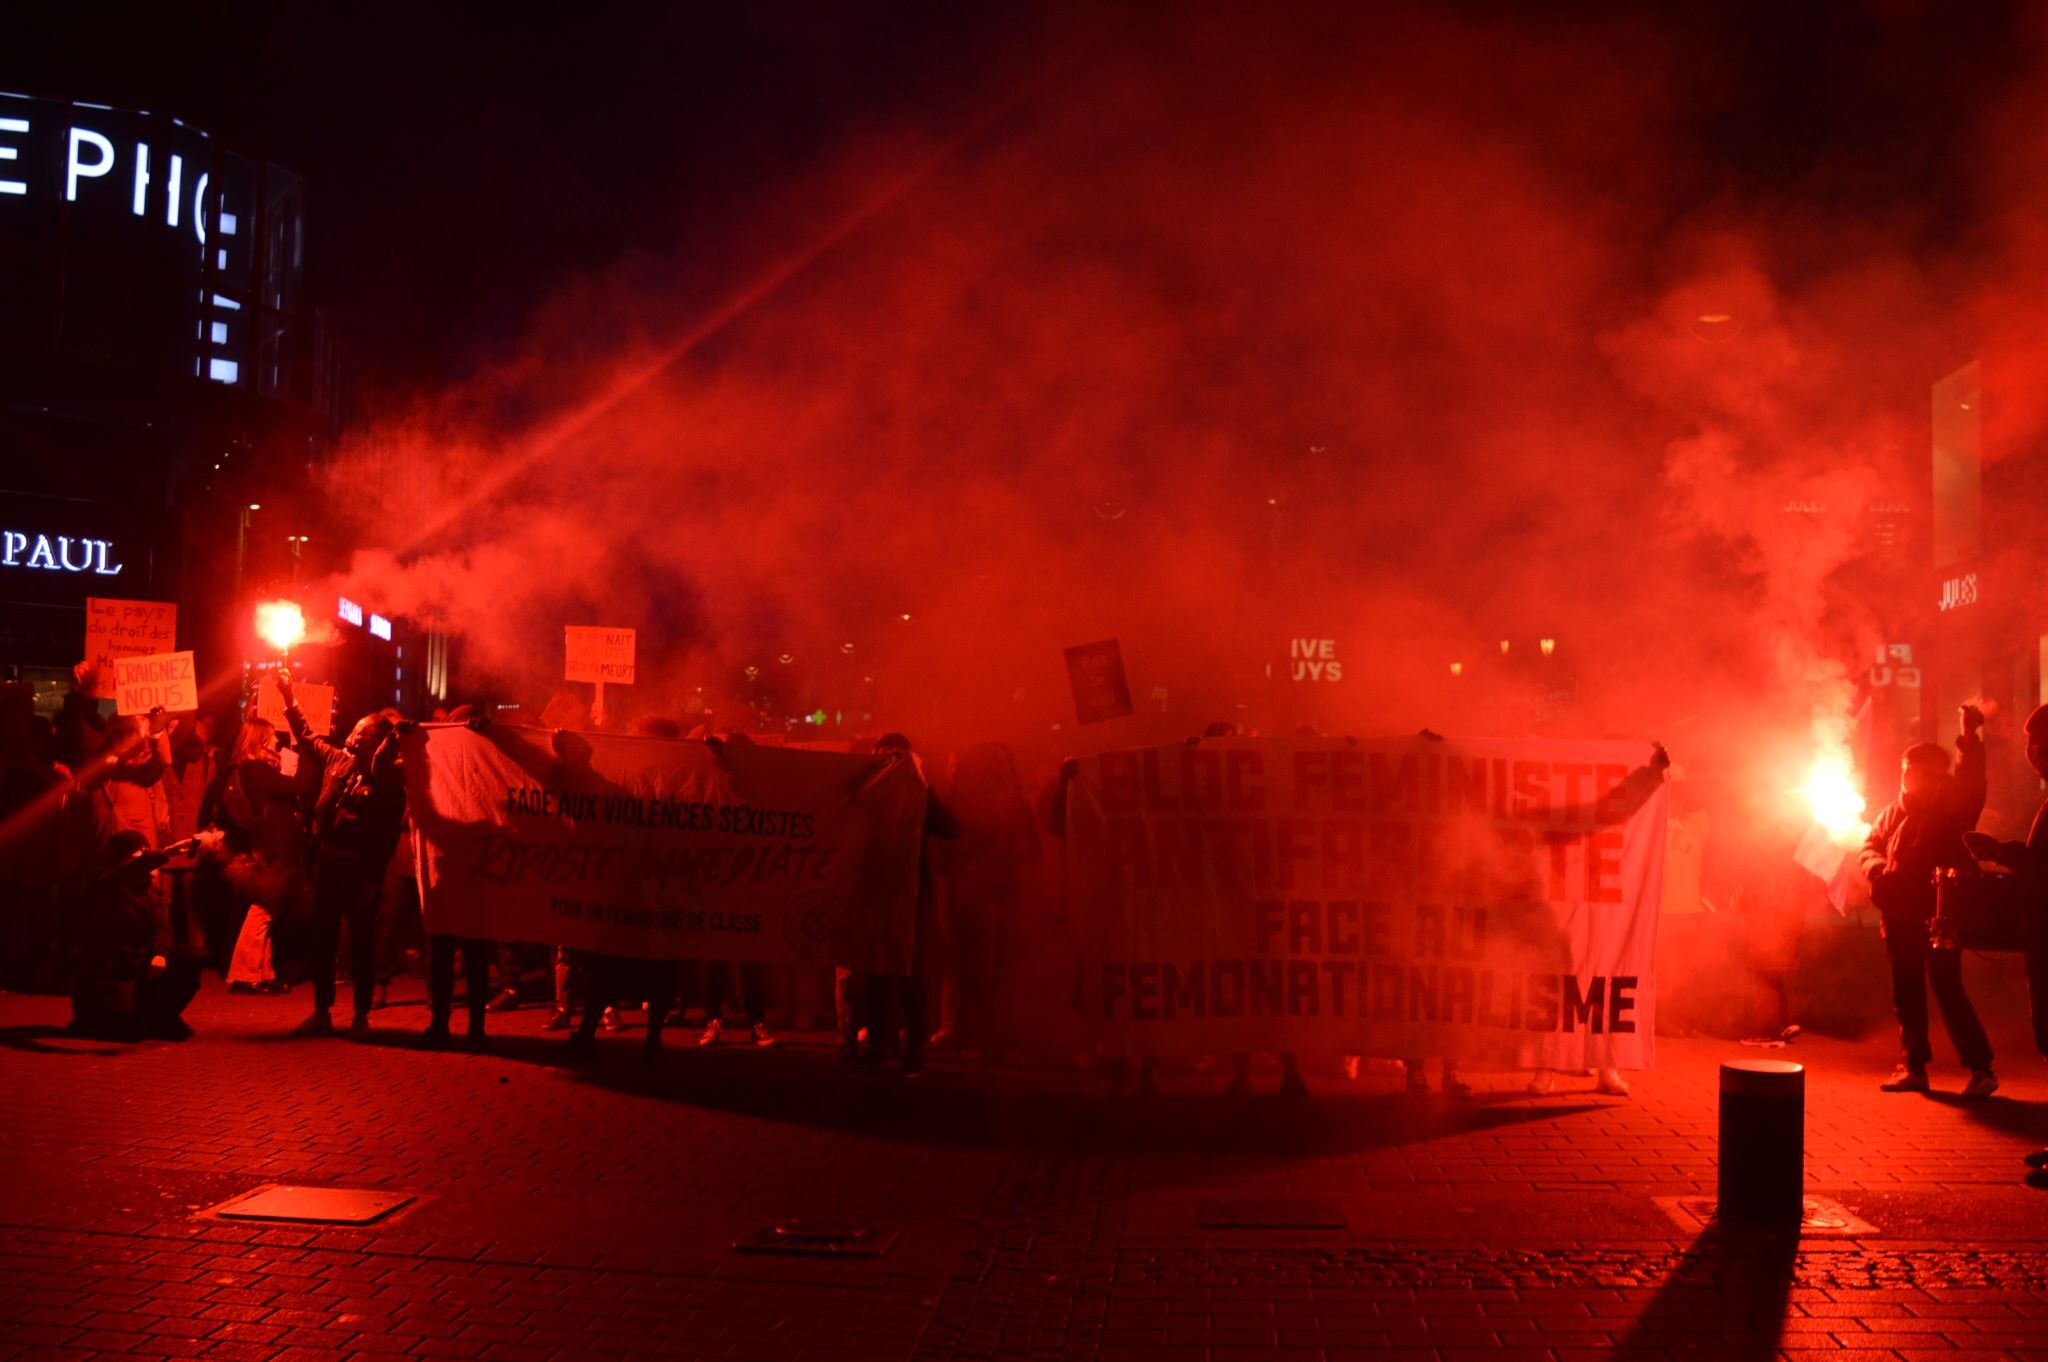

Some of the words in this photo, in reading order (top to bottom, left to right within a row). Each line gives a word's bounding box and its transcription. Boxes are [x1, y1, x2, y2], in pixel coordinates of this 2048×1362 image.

[2, 530, 122, 575] PAUL
[1937, 573, 1977, 612] JULES
[89, 618, 106, 635] du
[91, 600, 115, 617] Le
[123, 606, 165, 626] pays
[606, 633, 633, 646] NAIT
[1290, 637, 1337, 659] IVE
[116, 658, 192, 686] CRAIGNEZ
[600, 663, 634, 679] MEURT
[1266, 660, 1343, 682] UYS
[1099, 750, 1265, 815] BLOC
[1293, 751, 1629, 824] FEMINISTE
[559, 791, 599, 823] AUX
[604, 795, 714, 832] VIOLENCES
[719, 805, 817, 839] SEXISTES
[470, 834, 625, 886] RIPOSTE
[551, 896, 584, 919] POUR
[587, 902, 604, 921] UN
[687, 911, 705, 930] DE
[709, 911, 762, 933] CLASSE
[1255, 900, 1399, 956] FACE
[1415, 903, 1488, 958] AU
[1103, 960, 1637, 1035] FEMONATIONALISME
